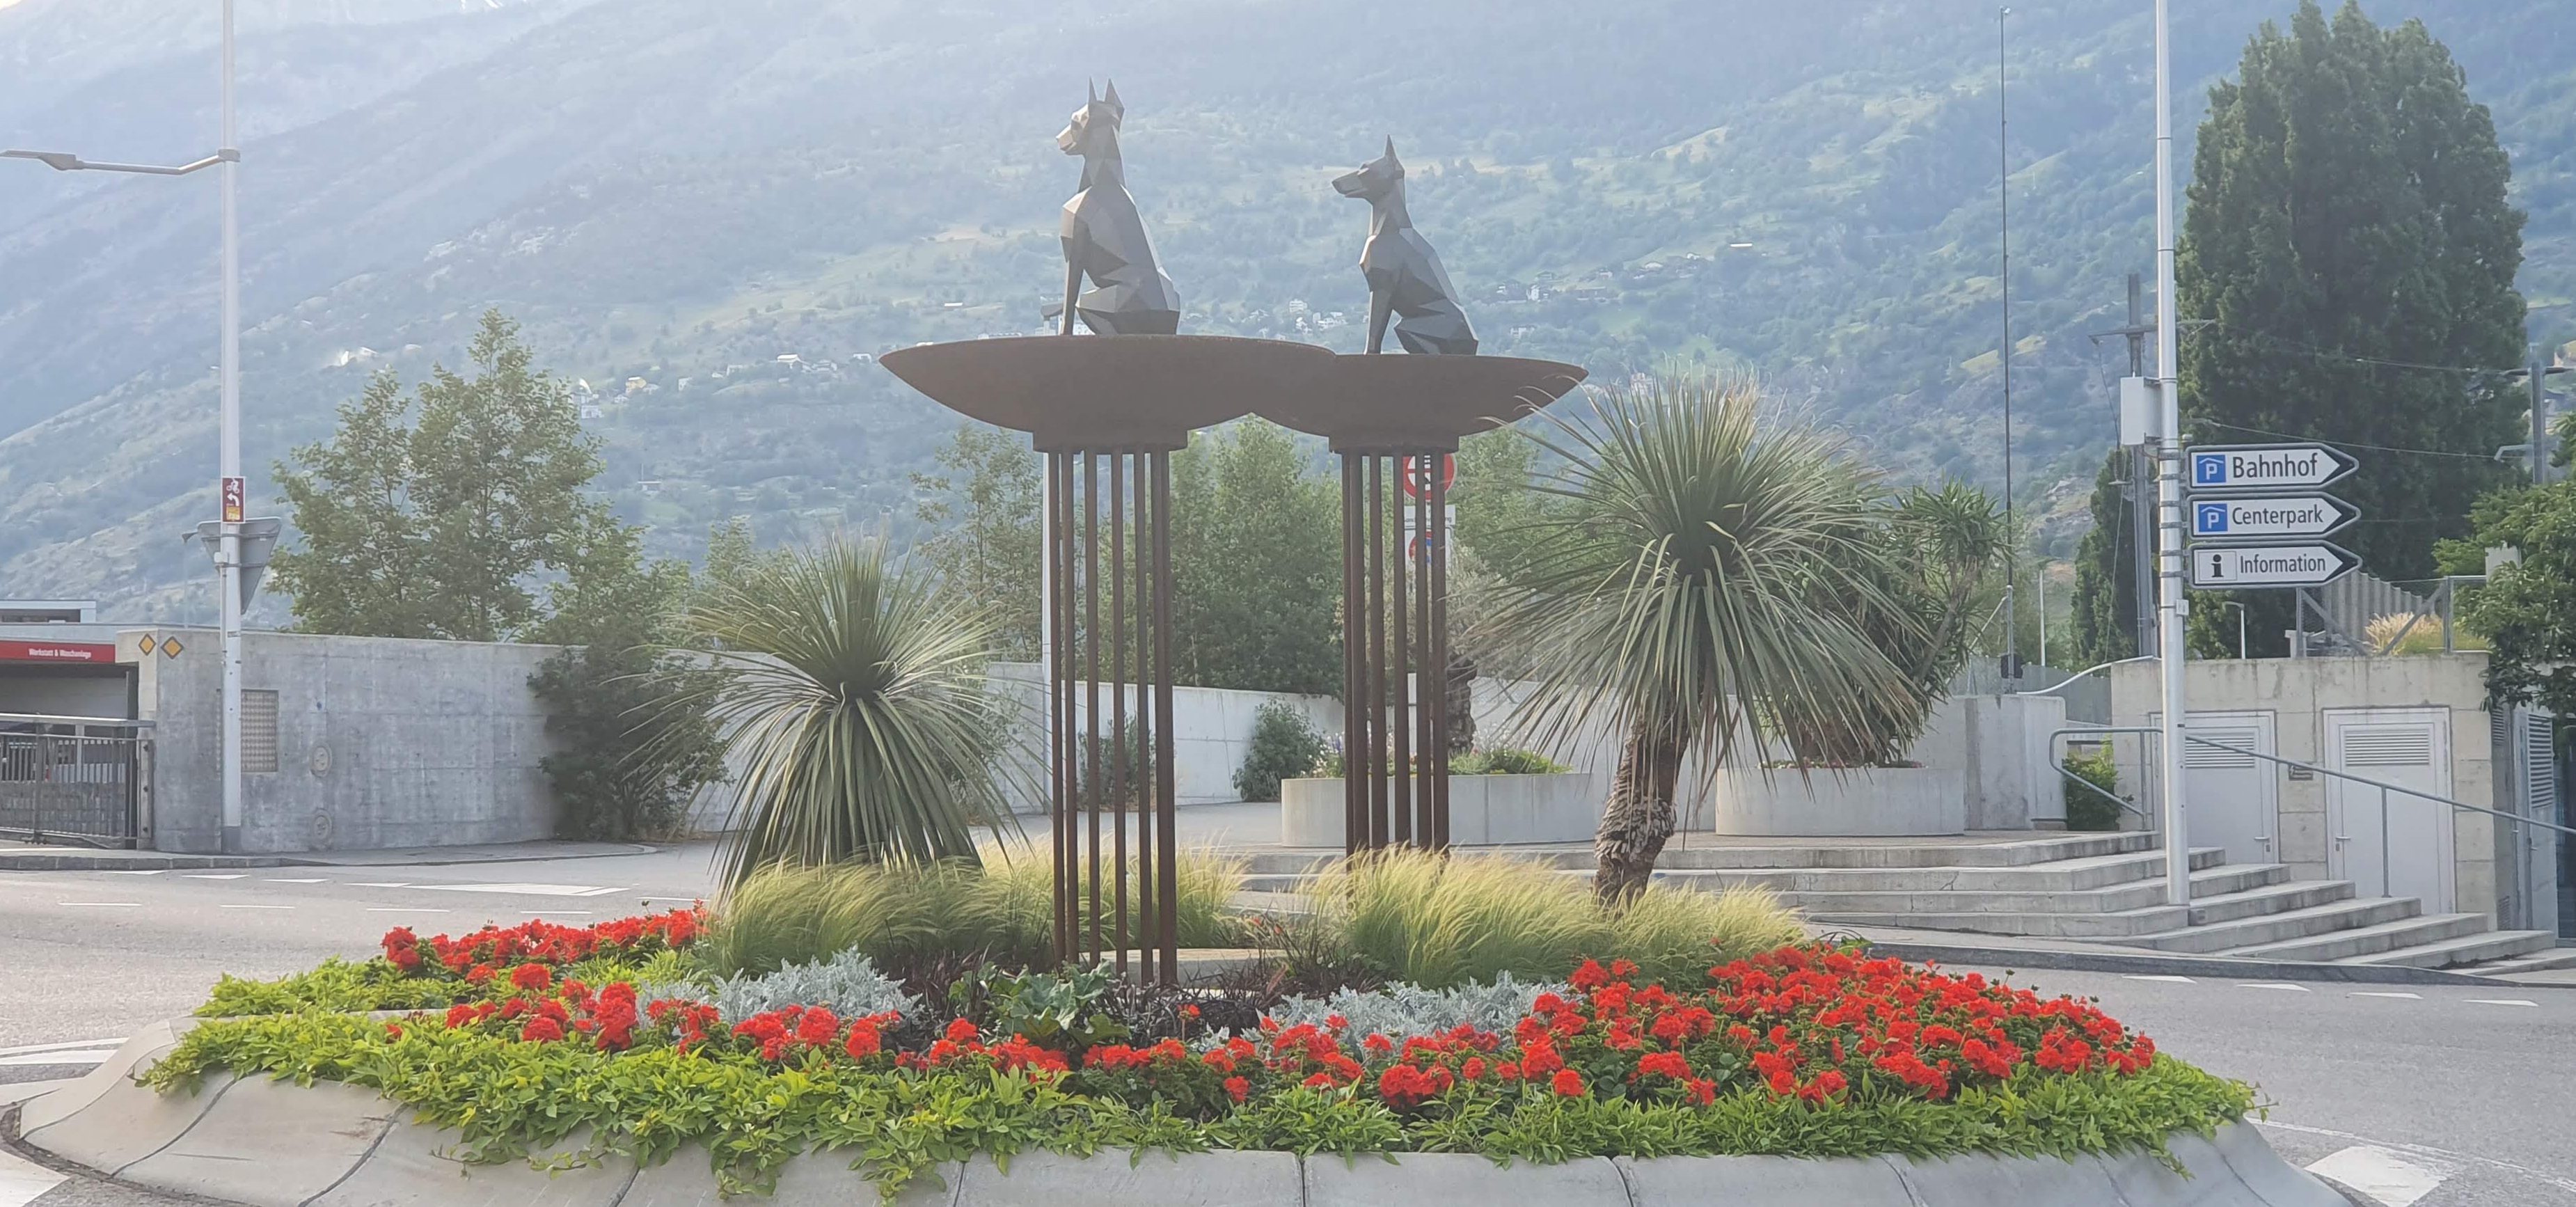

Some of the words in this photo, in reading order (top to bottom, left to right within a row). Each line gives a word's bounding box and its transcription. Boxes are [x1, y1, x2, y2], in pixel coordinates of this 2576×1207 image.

[2232, 452, 2318, 478] Bahnhof
[2232, 504, 2323, 528] Centerpark
[2240, 553, 2326, 574] Information
